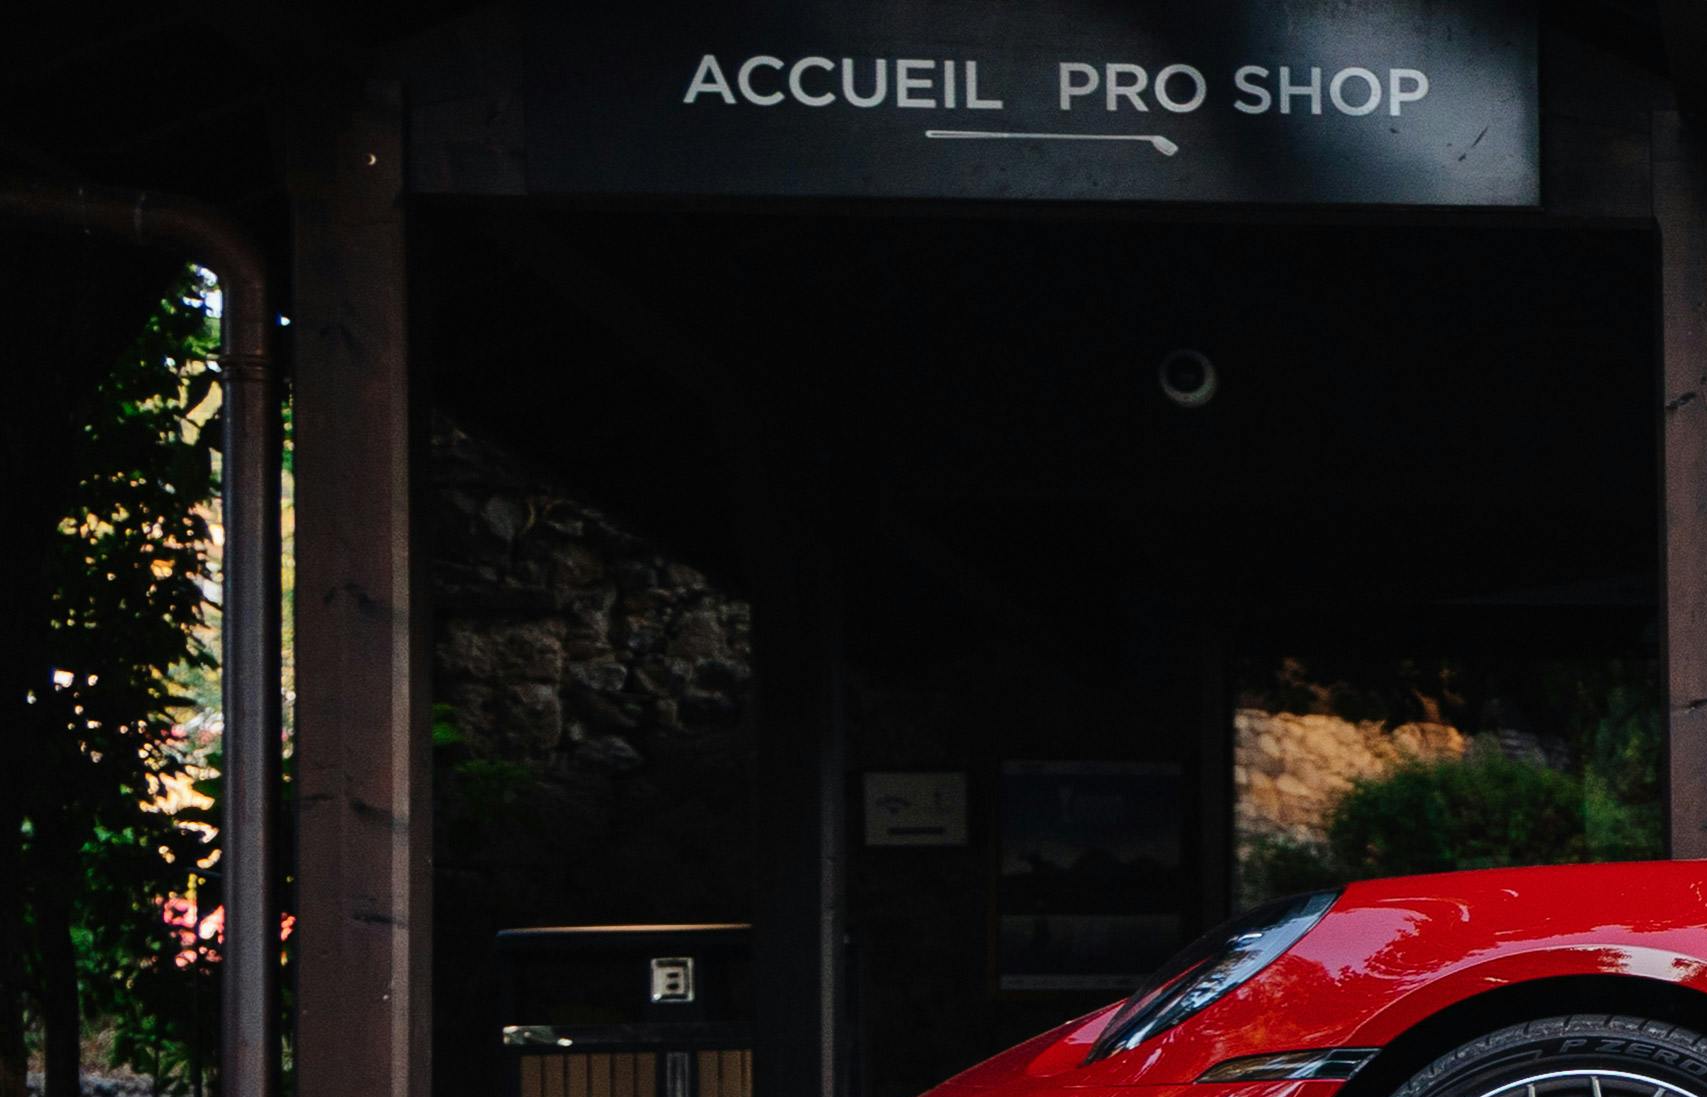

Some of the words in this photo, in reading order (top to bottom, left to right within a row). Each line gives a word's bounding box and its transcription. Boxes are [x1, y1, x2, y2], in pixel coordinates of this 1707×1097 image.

[683, 54, 1003, 111] ACCUEIL
[1058, 61, 1207, 114] PRO
[1232, 64, 1430, 117] SHOP
[1559, 1038, 1588, 1054] P
